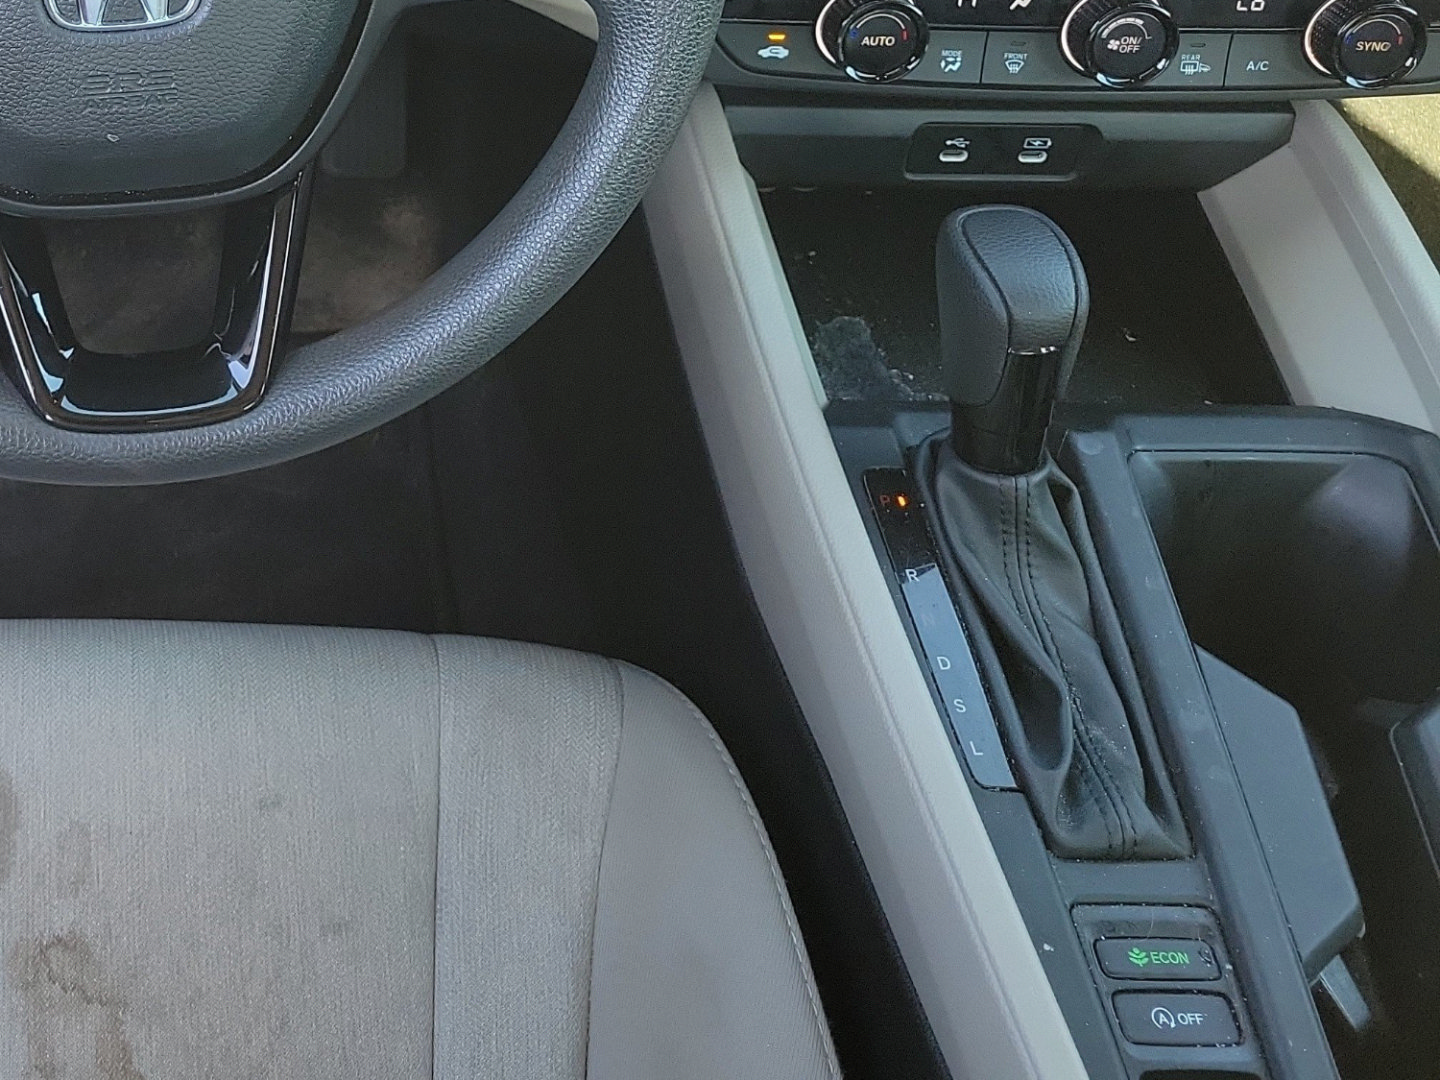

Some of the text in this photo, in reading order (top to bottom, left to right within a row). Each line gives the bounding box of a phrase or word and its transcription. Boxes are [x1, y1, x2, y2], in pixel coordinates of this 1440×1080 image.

[860, 36, 896, 47] AUTO
[1355, 41, 1392, 52] SYNC
[941, 49, 962, 57] MODE
[1119, 45, 1141, 54] OFF
[1004, 52, 1028, 60] FRONT
[1246, 60, 1270, 72] A/C
[905, 568, 921, 582] R
[936, 656, 951, 671] D
[953, 699, 967, 714] S
[969, 741, 984, 756] L
[1150, 951, 1190, 964] ECON
[1177, 1012, 1204, 1025] OFF
